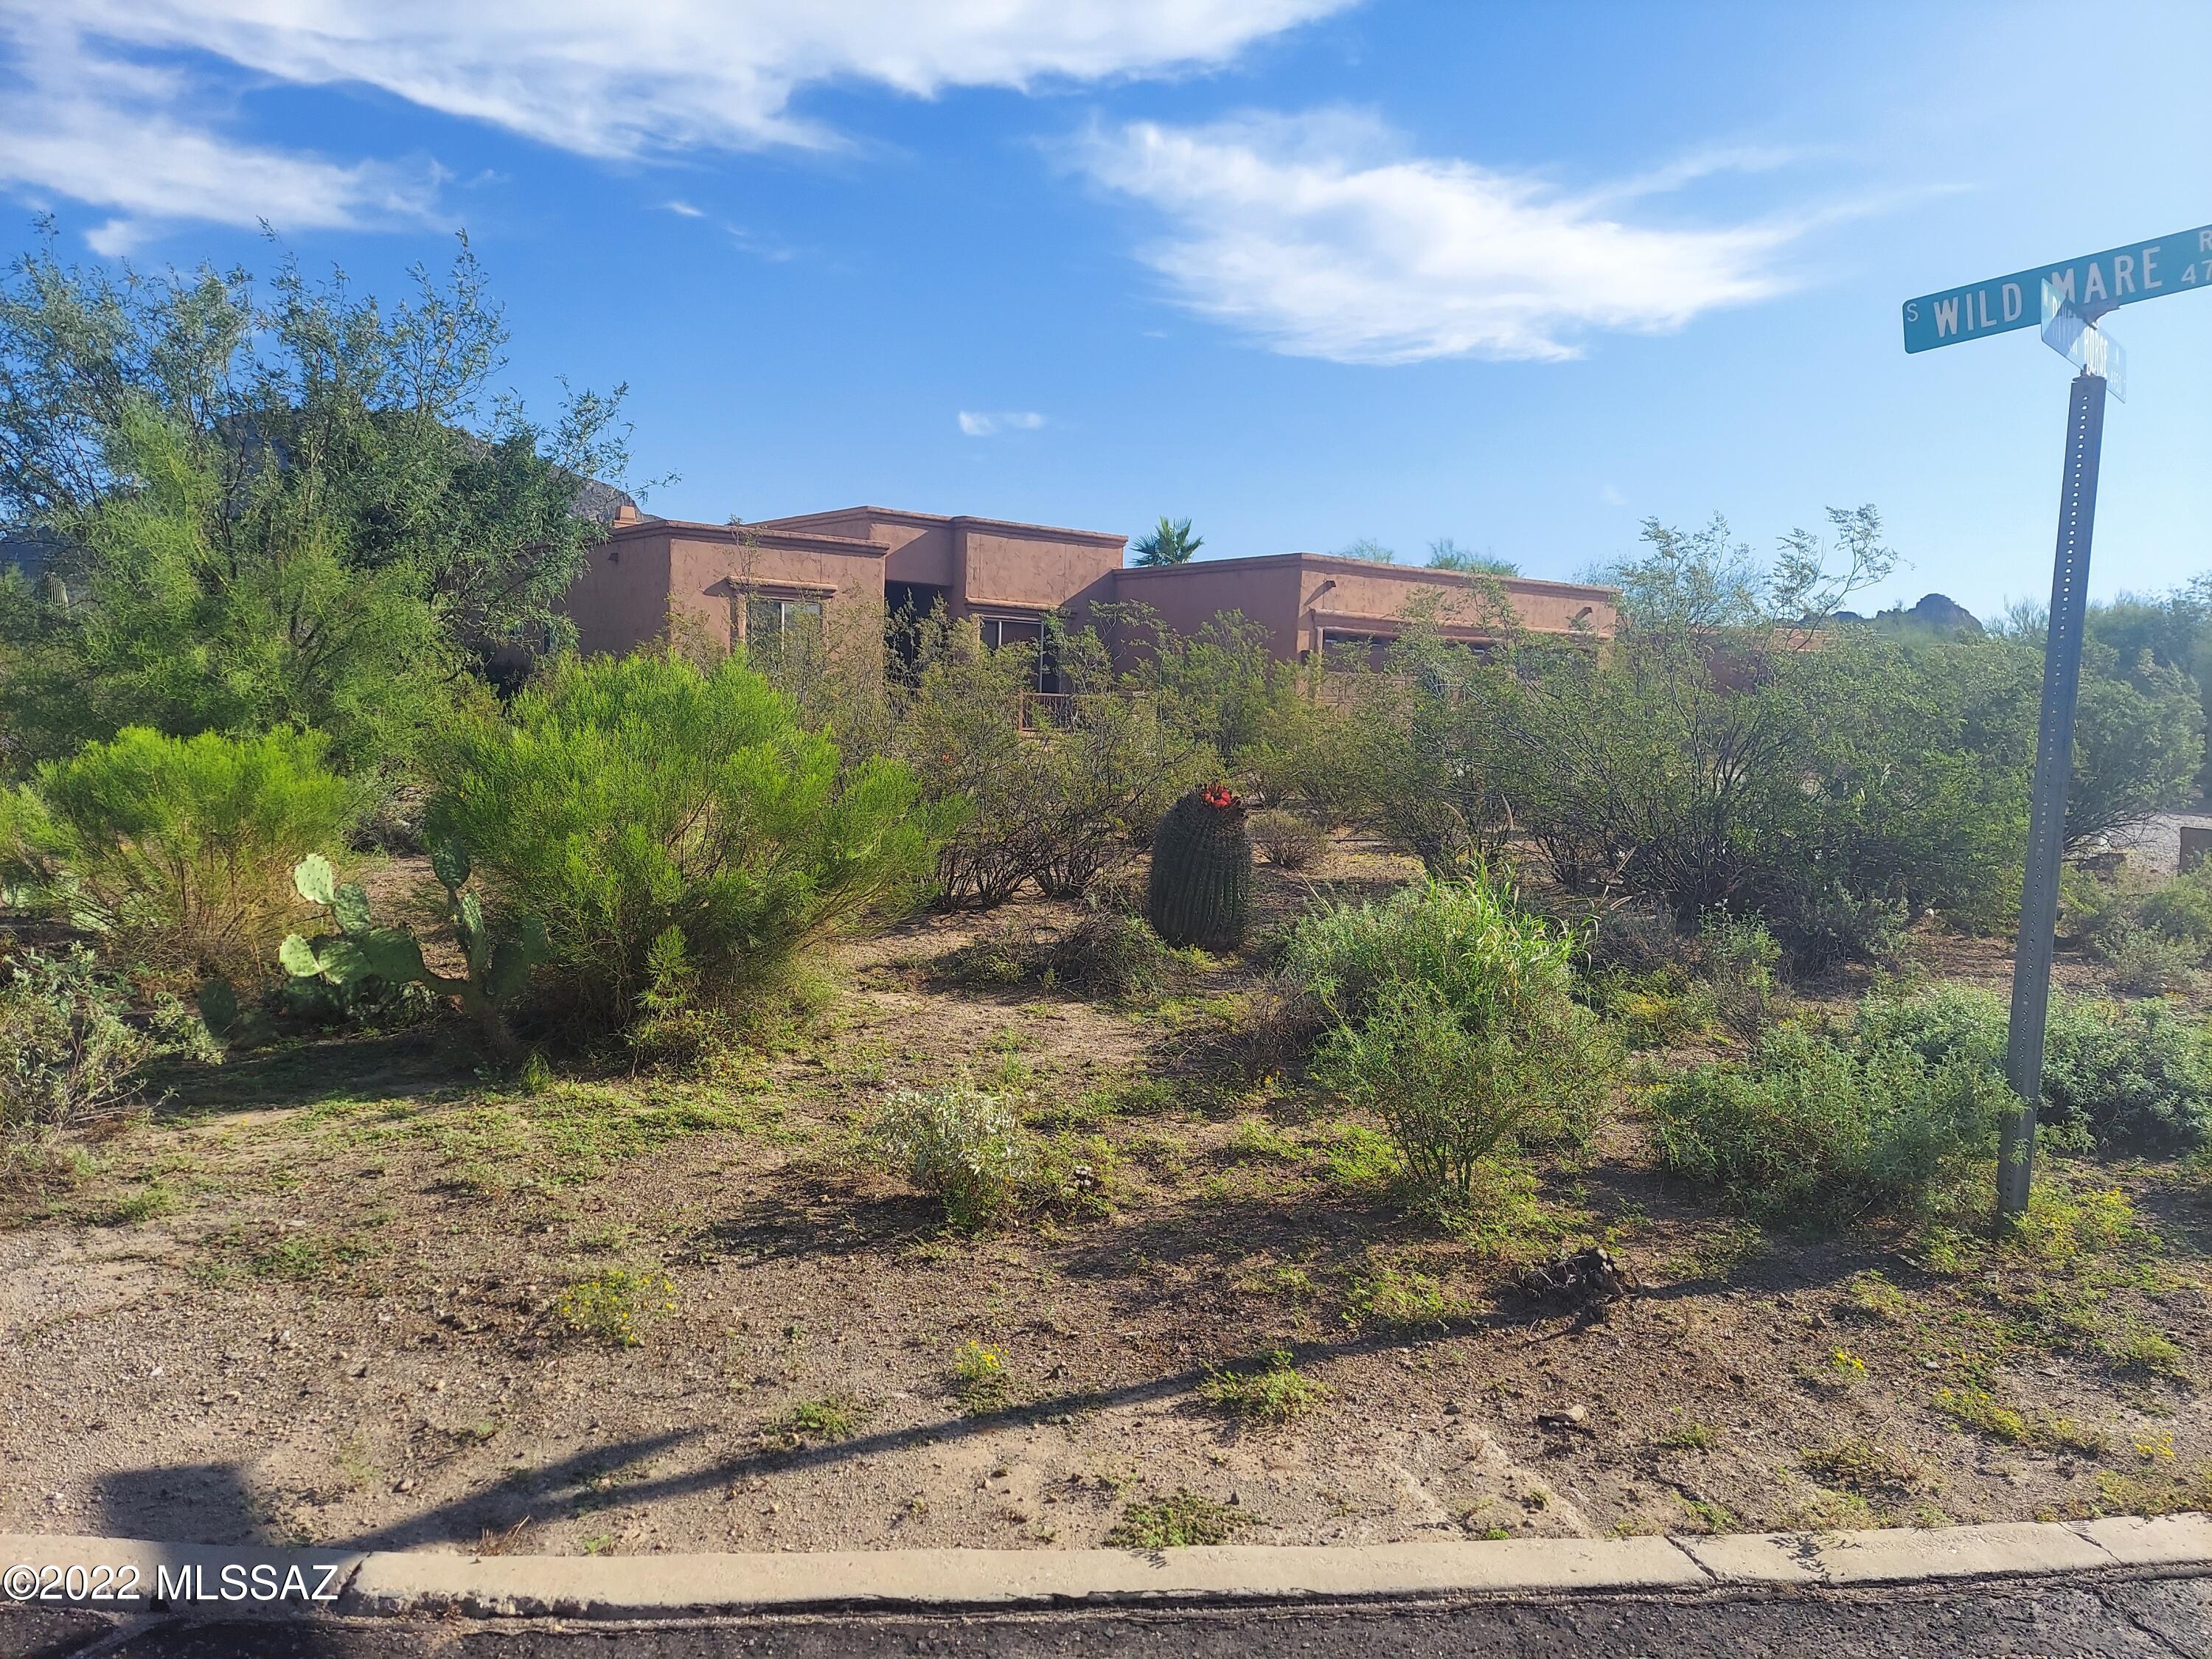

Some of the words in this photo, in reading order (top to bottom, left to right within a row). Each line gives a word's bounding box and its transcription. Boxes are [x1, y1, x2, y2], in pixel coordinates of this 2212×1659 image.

[1906, 302, 1919, 322] S
[1933, 282, 2023, 338] WILD
[2051, 246, 2163, 304] MARE
[2084, 325, 2108, 378] HORSE
